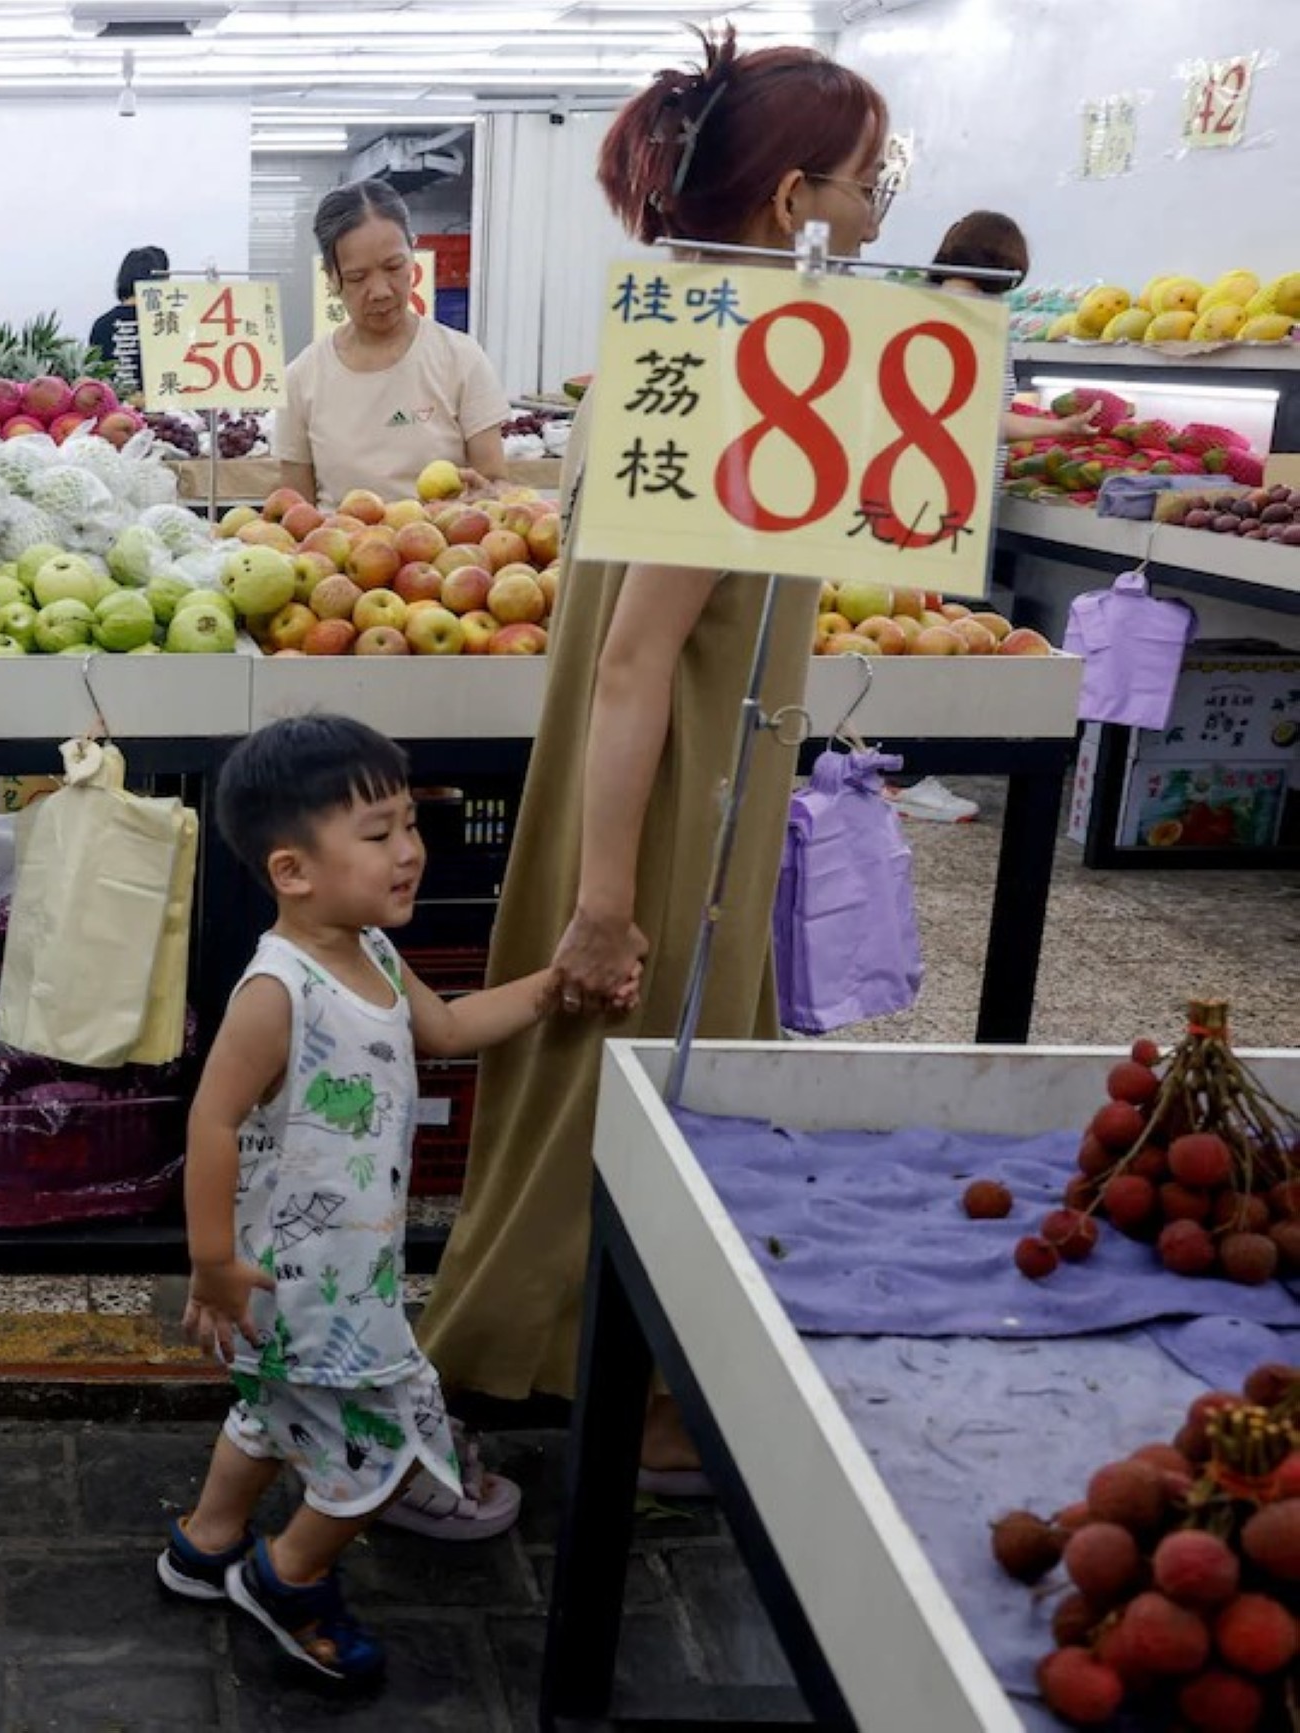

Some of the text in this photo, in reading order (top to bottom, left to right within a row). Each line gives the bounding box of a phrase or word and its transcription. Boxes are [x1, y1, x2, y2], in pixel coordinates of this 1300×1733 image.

[142, 287, 189, 311] 富士
[200, 286, 243, 336] 4
[611, 273, 752, 327] 桂味
[153, 312, 182, 396] 蘋果
[182, 341, 279, 394] 50 元
[616, 349, 706, 500] 荔枝
[713, 300, 978, 549] 88
[846, 501, 975, 554] 元/斤
